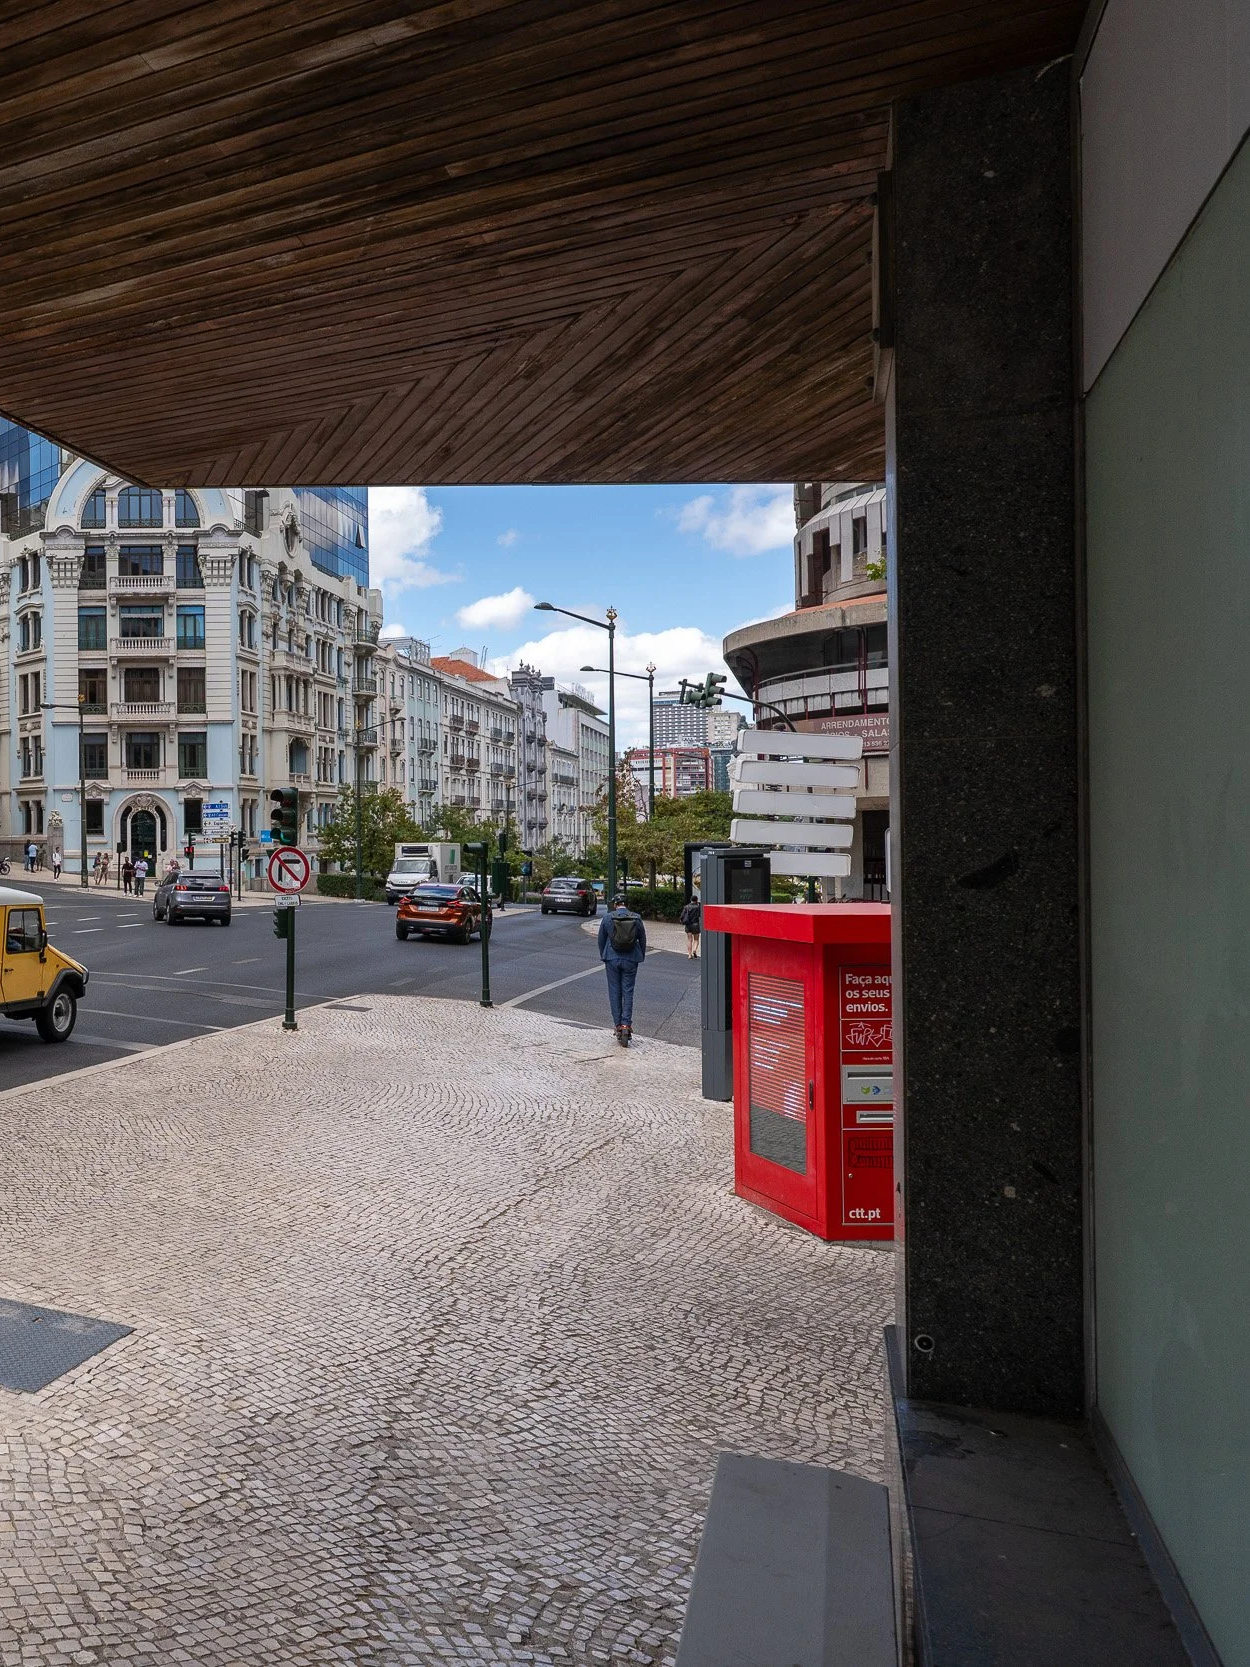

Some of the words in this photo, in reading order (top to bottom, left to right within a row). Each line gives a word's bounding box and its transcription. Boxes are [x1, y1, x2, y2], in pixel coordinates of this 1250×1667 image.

[845, 973, 872, 987] Faça
[845, 990, 860, 999] os
[861, 989, 890, 998] seus
[845, 1001, 889, 1013] envios.
[848, 1207, 881, 1221] ctt.pt
